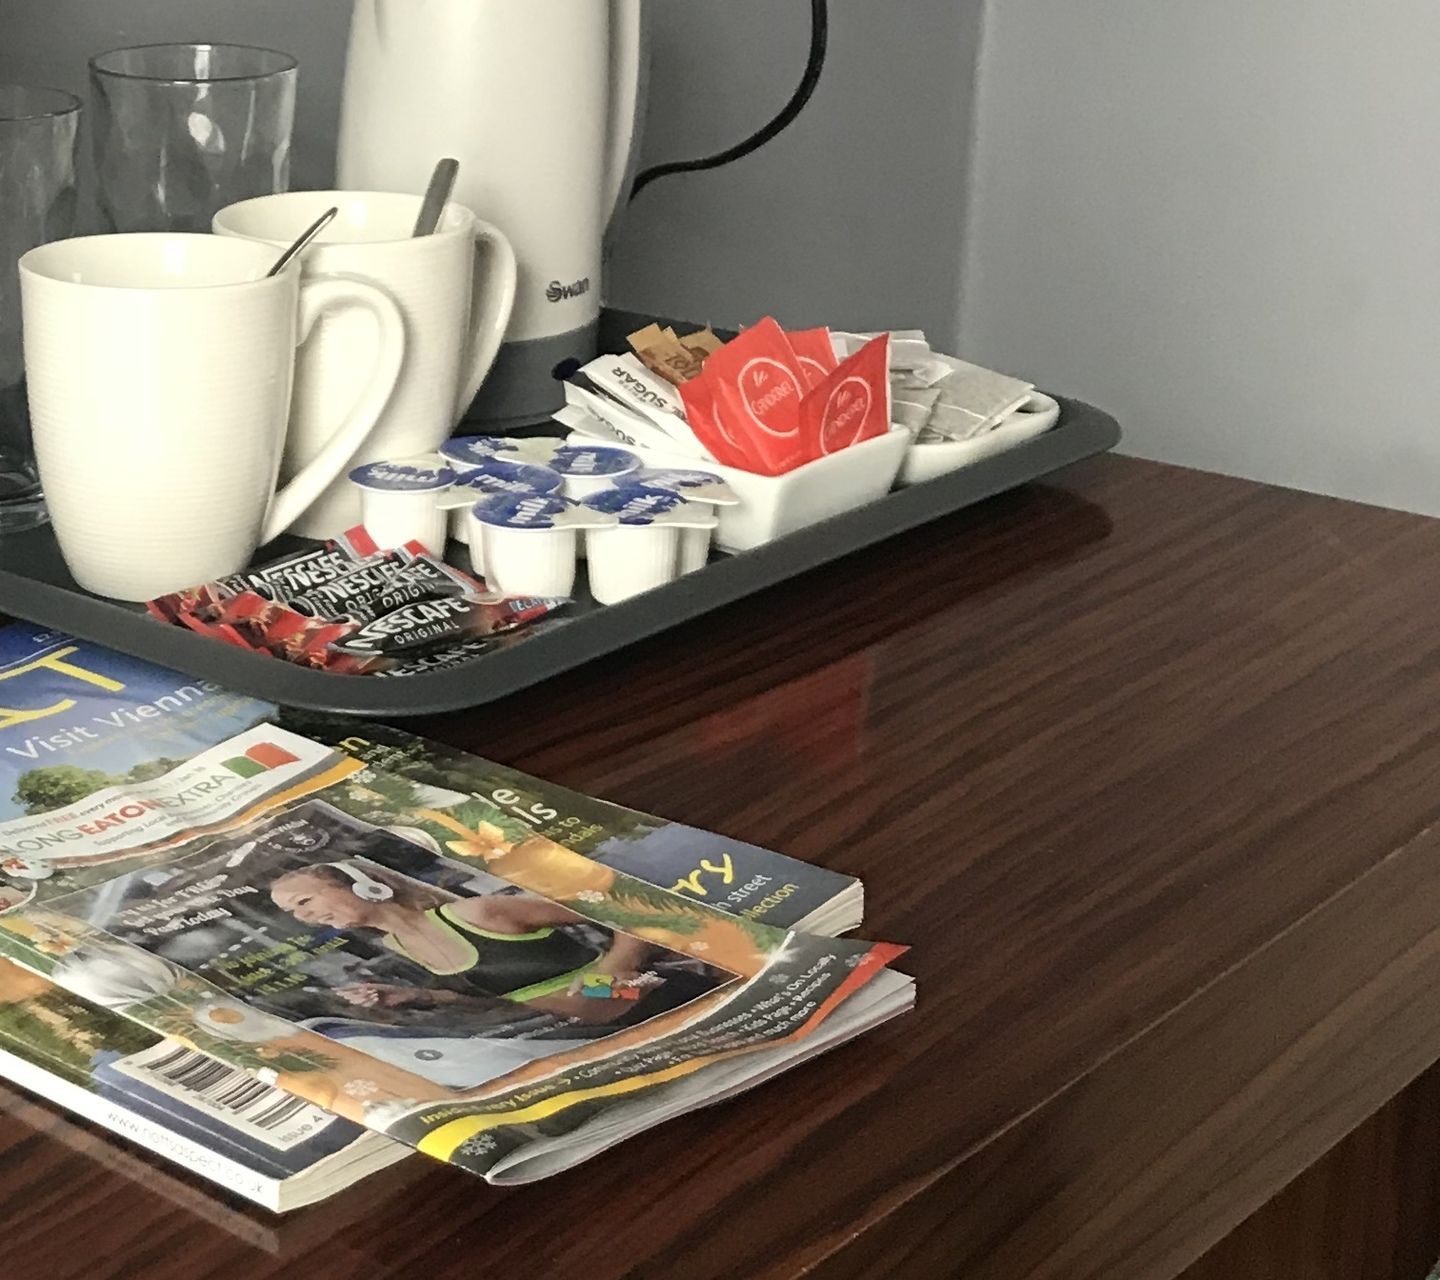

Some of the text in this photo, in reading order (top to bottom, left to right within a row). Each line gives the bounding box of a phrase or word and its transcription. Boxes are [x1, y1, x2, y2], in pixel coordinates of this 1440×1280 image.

[545, 277, 589, 303] Swan
[610, 366, 668, 408] SUGAR
[393, 620, 460, 645] ORIGINAL
[6, 724, 98, 759] Visit
[92, 681, 221, 729] Vienna
[727, 874, 773, 904] street
